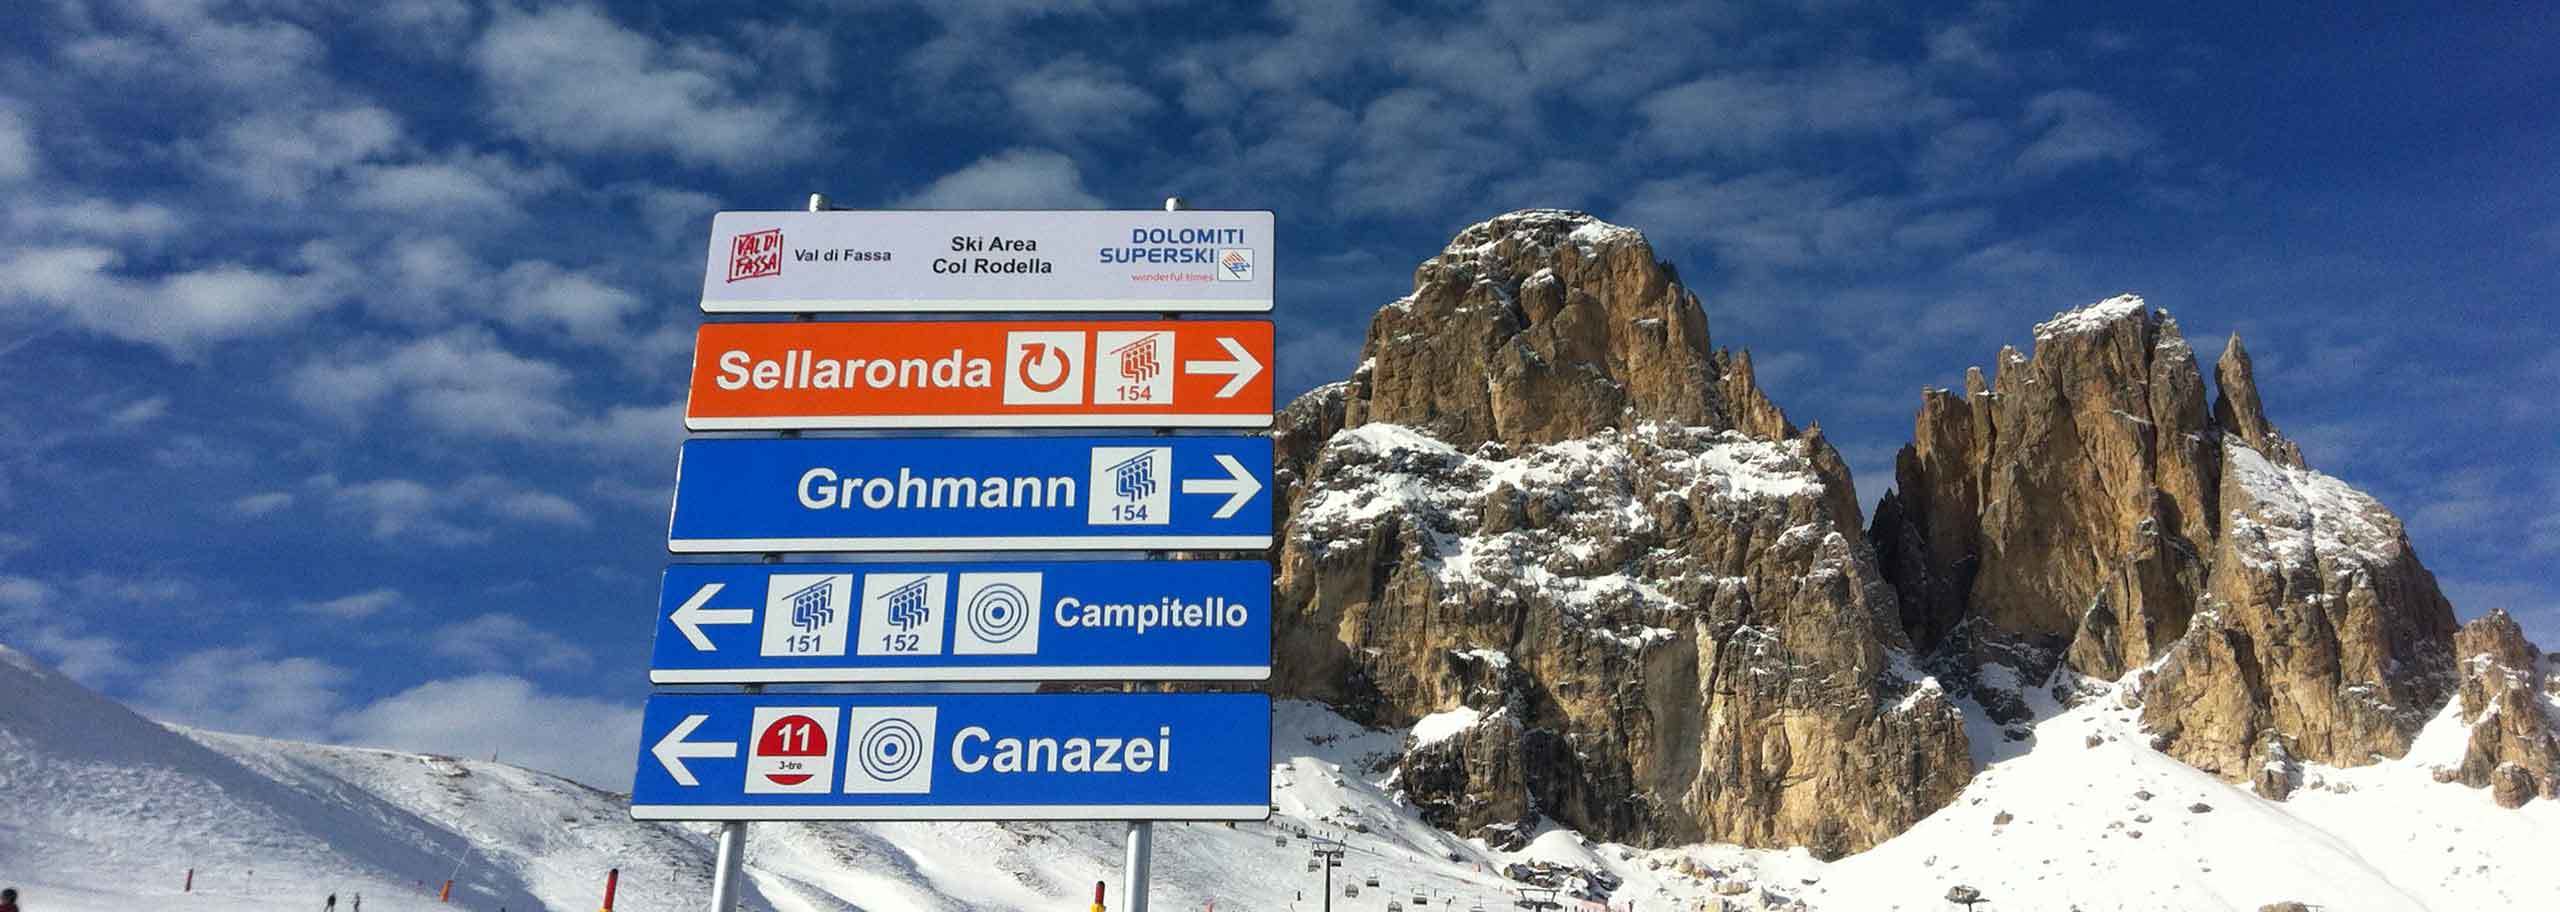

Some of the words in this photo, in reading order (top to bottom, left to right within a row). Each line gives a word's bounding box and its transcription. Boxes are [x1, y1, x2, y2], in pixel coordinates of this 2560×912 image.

[738, 235, 761, 255] VAL
[763, 234, 778, 249] DI
[951, 236, 982, 251] Ski
[989, 236, 1037, 251] Area
[1132, 228, 1244, 244] DOLOMITI
[794, 248, 818, 262] Val
[824, 248, 838, 262] di
[843, 248, 892, 262] Fassa
[1100, 248, 1215, 263] SUPERSKI
[735, 254, 777, 277] FASSA
[932, 258, 966, 274] Col
[973, 258, 1052, 274] Rodella
[1131, 272, 1183, 282] wonderful
[1184, 272, 1214, 282] times
[715, 349, 992, 391] Sellaronda
[1116, 385, 1152, 401] 154
[798, 467, 1076, 510] Grohmann
[1111, 504, 1148, 522] 154
[1054, 597, 1249, 633] Campitello
[785, 634, 822, 653] 151
[882, 633, 920, 652] 152
[776, 723, 811, 753] 11
[951, 725, 1171, 774] Canazei
